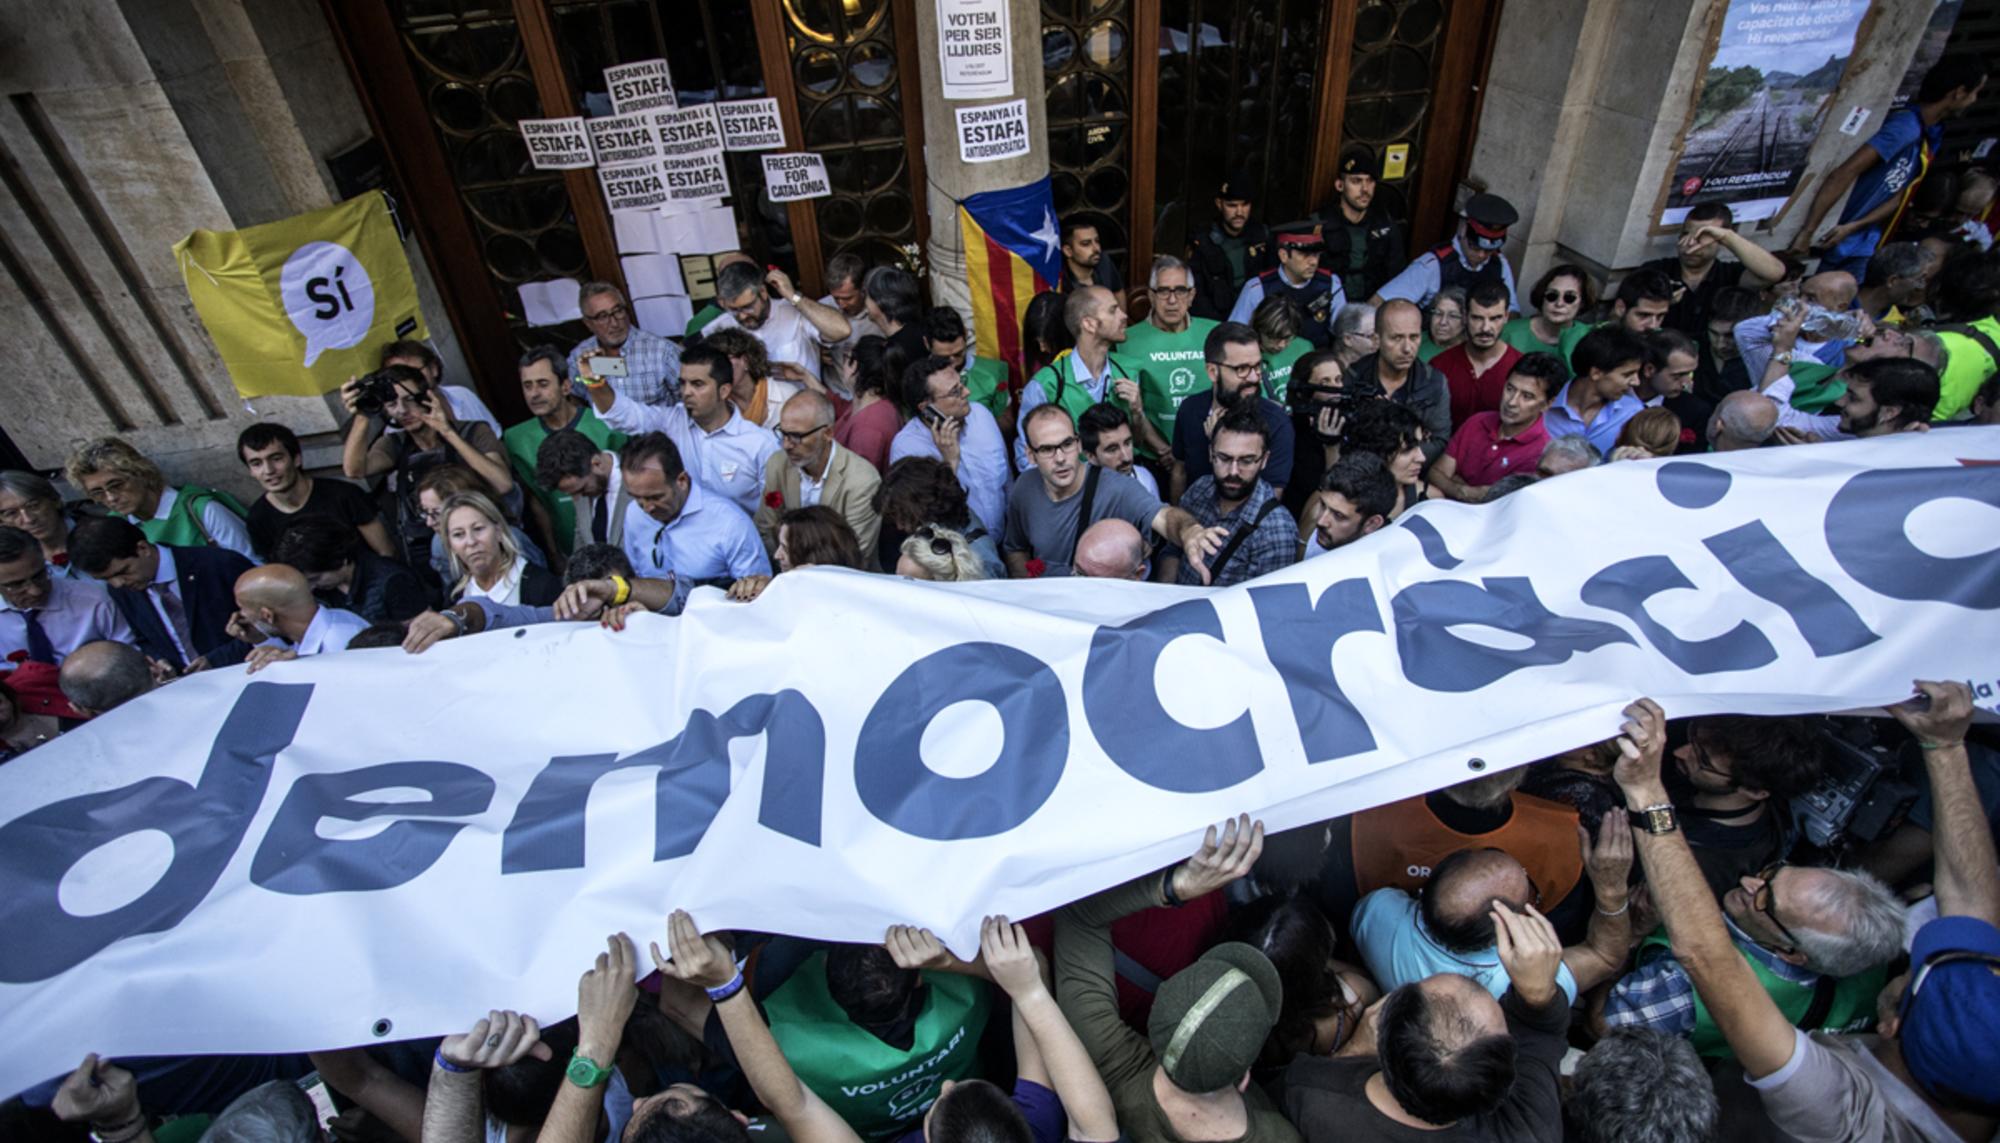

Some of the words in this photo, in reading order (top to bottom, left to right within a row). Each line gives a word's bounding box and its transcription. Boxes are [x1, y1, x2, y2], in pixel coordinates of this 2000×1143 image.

[947, 11, 996, 27] VOTEM
[1737, 16, 1793, 32] capacitat
[1795, 13, 1814, 26] de
[945, 28, 970, 42] PER
[974, 26, 1002, 41] SER
[946, 42, 1002, 58] LLIURES
[608, 64, 654, 82] ESPANYA
[613, 76, 671, 101] ESTAFA
[655, 109, 699, 125] ESPANYA
[720, 104, 762, 116] ESPANYA
[961, 108, 1010, 124] ESPANYA
[524, 122, 567, 134] ESPANYA
[590, 118, 635, 133] ESPANYA
[659, 120, 716, 143] ESTAFA
[724, 115, 779, 134] ESTAFA
[963, 119, 1025, 145] ESTAFA
[529, 135, 586, 152] ESTAFA
[595, 128, 653, 150] ESTAFA
[663, 156, 706, 170] ESPANYA
[766, 155, 821, 171] FREEDOM
[602, 166, 646, 181] ESPANYA
[667, 166, 723, 187] ESTAFA
[784, 168, 809, 184] FOR
[607, 176, 664, 197] ESTAFA
[771, 179, 828, 199] CATALONIA
[841, 1026, 965, 1097] VOLUNTARI
